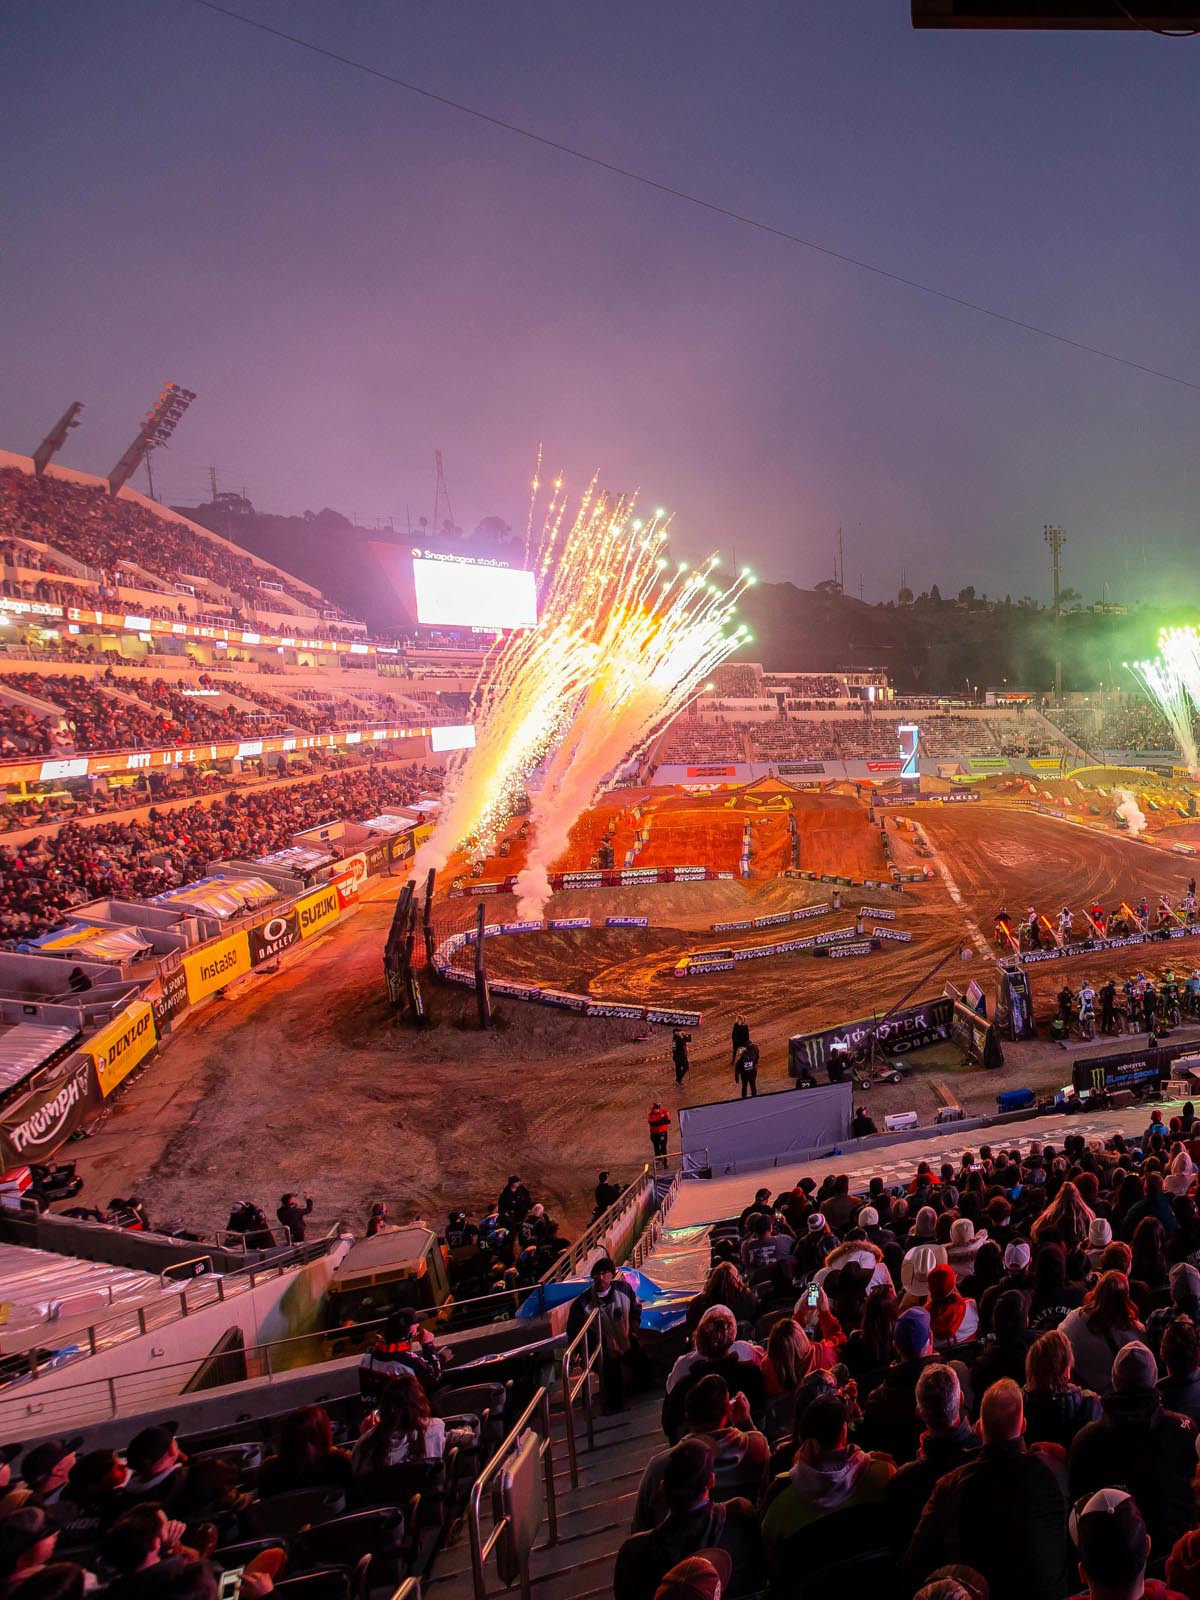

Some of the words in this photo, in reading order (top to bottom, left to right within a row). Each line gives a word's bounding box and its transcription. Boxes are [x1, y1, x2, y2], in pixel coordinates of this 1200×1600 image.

[424, 550, 476, 564] Snapdragon
[301, 895, 337, 928] SUZUKI
[504, 921, 541, 930] FALKEN
[554, 919, 591, 928] FALKEN
[258, 933, 295, 960] OAKLEY
[200, 949, 237, 982] Insta360
[488, 985, 530, 997] FALKEN
[540, 994, 583, 1007] FALKEN
[108, 1013, 151, 1066] DUNLOP
[10, 1079, 79, 1153] TRIUMPH
